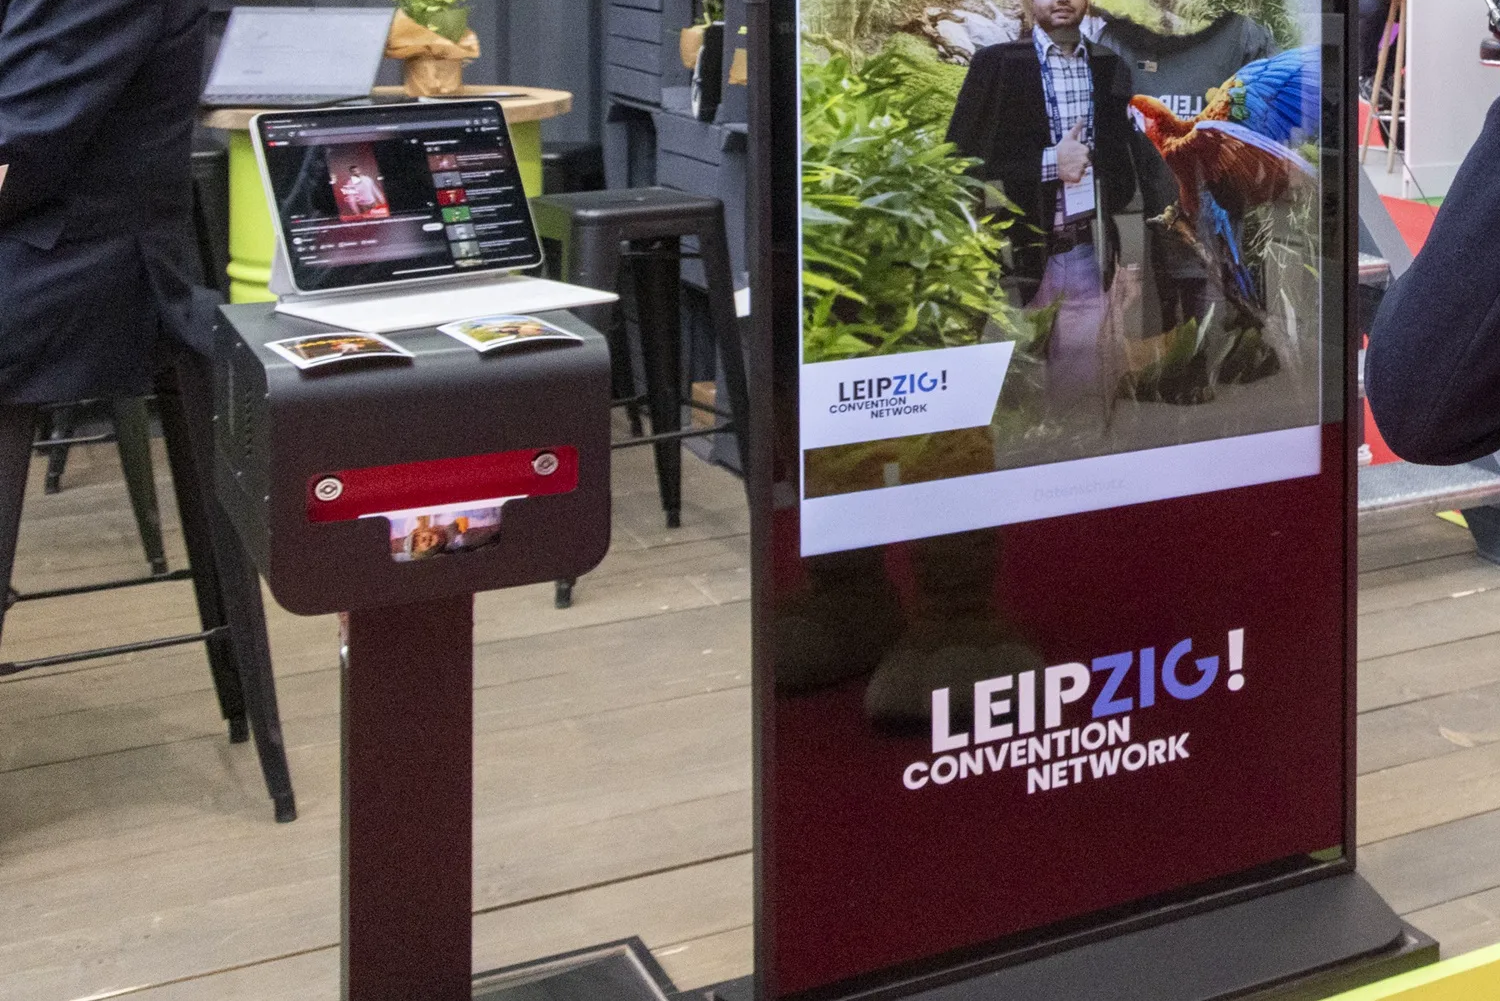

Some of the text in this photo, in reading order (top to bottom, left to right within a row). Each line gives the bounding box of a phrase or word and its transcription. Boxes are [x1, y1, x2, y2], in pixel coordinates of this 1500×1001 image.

[829, 396, 907, 414] CONVENTION
[838, 369, 948, 402] LEIPZIG!
[870, 403, 928, 419] NETWORK
[931, 627, 1246, 753] LEIPZIG!
[902, 716, 1131, 790] CONVENTION
[1027, 732, 1191, 795] NETWORK
